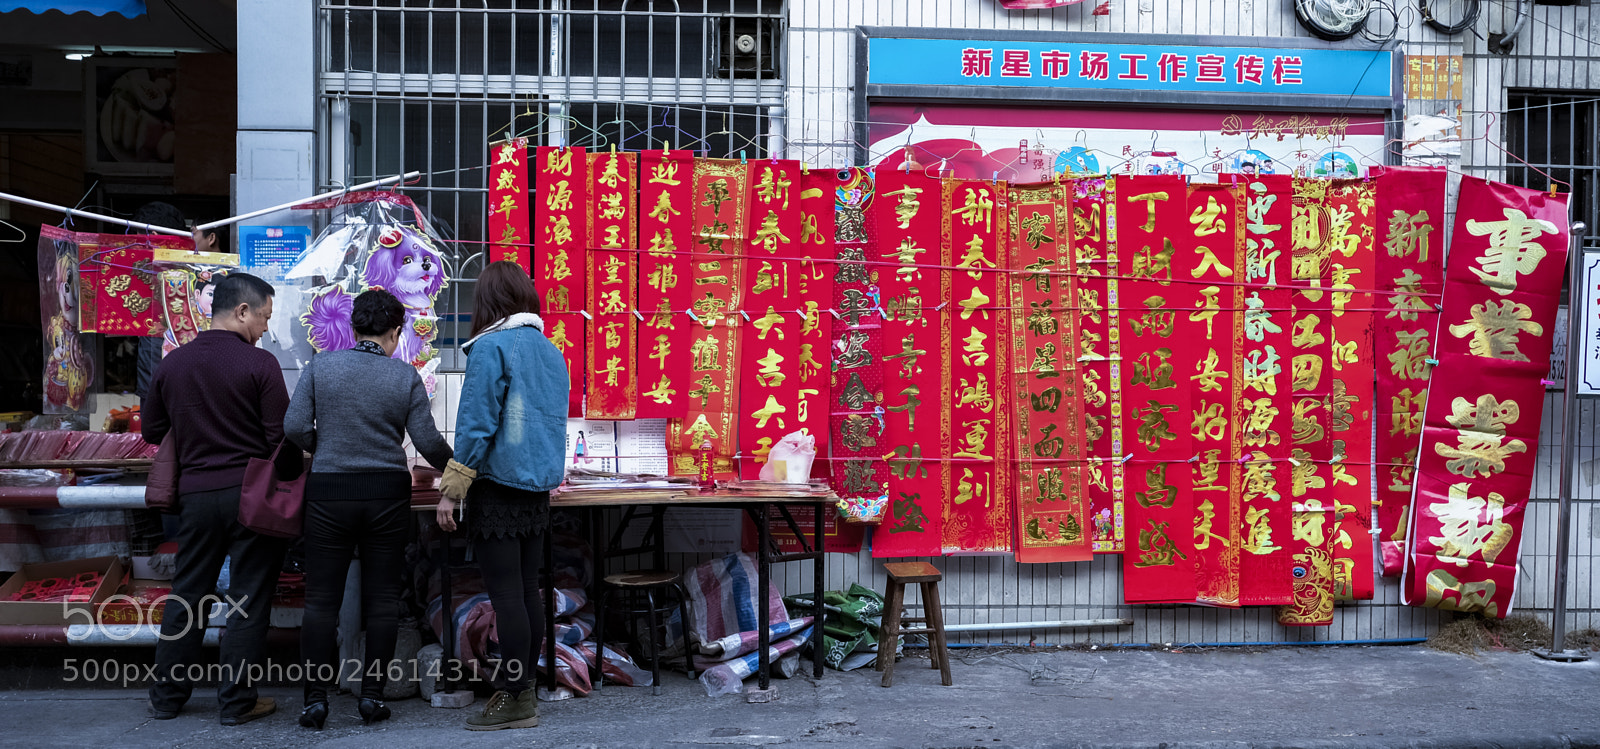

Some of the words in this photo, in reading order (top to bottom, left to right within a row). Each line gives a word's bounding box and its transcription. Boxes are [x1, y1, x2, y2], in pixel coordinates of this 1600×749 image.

[960, 48, 1303, 85] 新星市场工作宣传栏
[543, 147, 574, 390] 財源滾滾隨春
[951, 188, 997, 507] 新春大吉鴻運到
